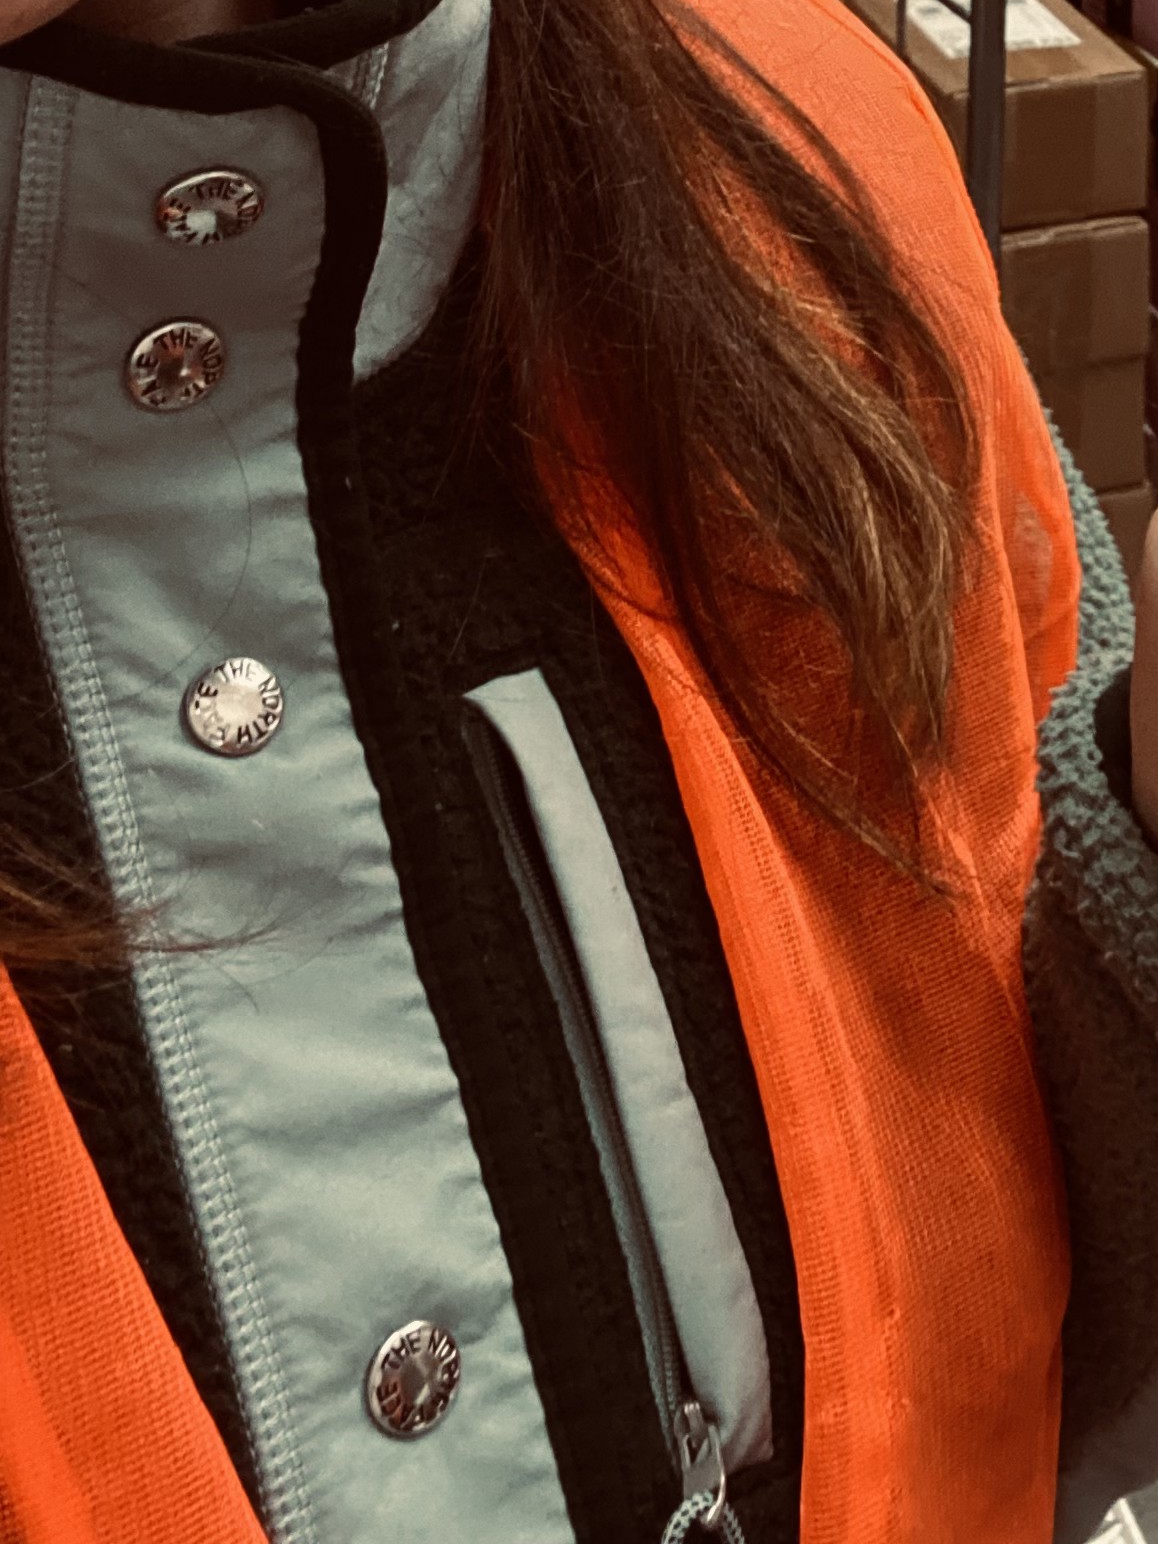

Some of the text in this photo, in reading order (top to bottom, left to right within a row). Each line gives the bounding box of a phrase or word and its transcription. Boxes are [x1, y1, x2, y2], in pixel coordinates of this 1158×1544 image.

[153, 327, 198, 351] THE
[213, 660, 257, 683] THE
[237, 675, 281, 744] NORTH
[380, 1331, 422, 1370] THE
